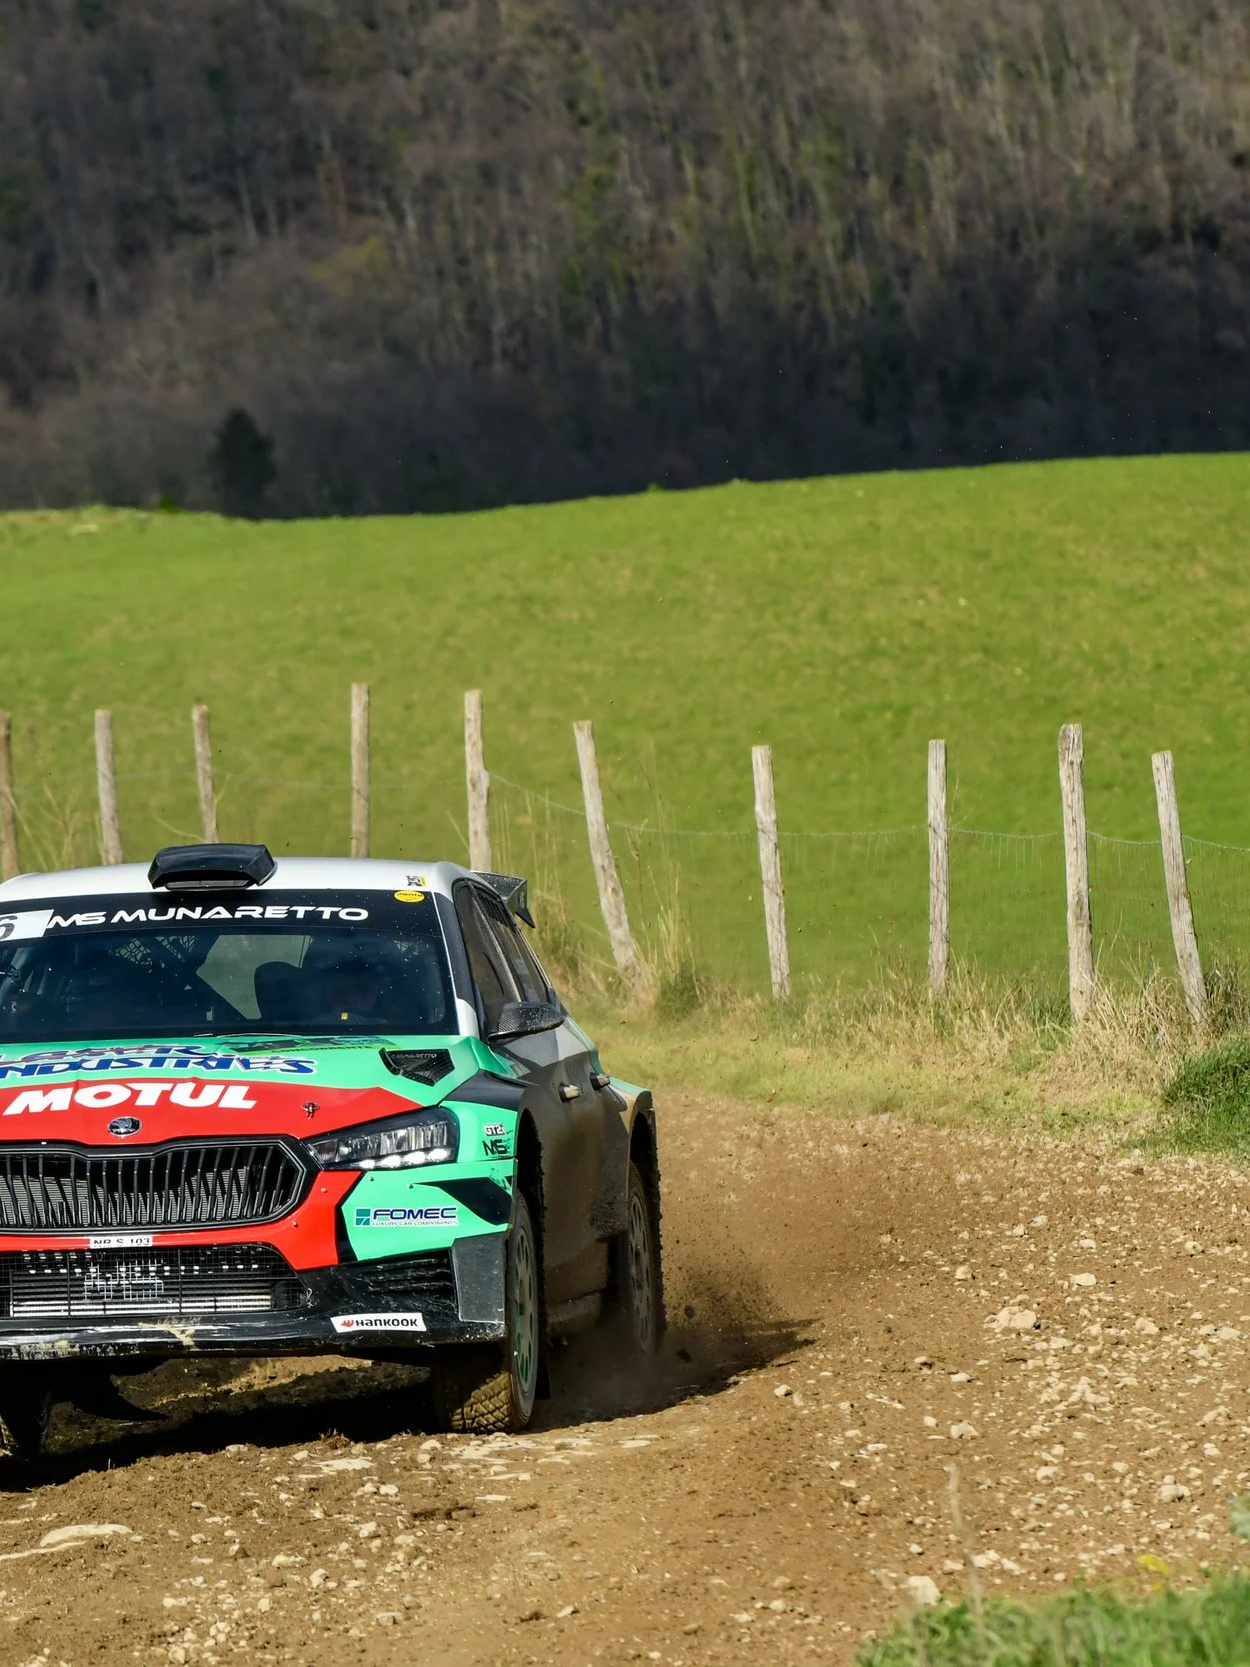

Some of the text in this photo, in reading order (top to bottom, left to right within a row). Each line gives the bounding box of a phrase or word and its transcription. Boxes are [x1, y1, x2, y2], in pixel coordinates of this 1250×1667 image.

[46, 905, 369, 929] MS MUNARETTO
[2, 1081, 257, 1116] MOTUL
[482, 1139, 508, 1156] MS
[373, 1208, 457, 1220] FOMEC
